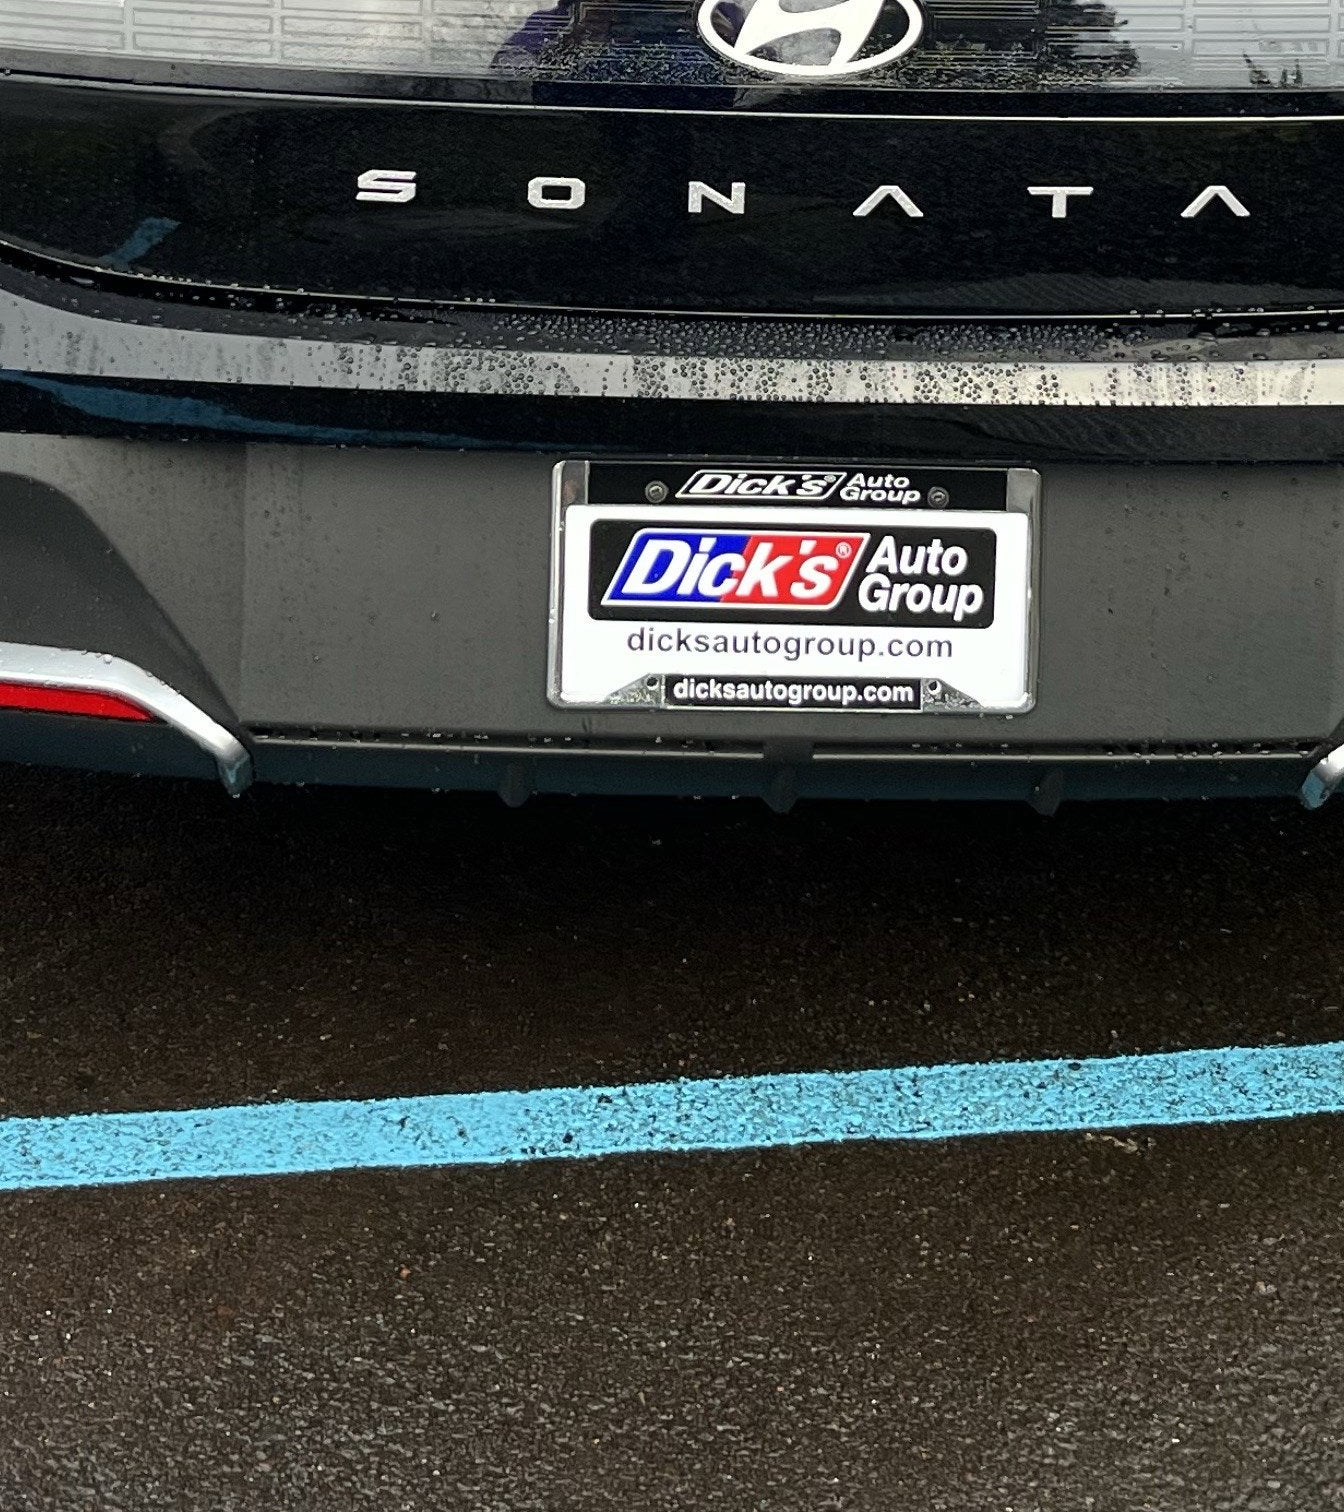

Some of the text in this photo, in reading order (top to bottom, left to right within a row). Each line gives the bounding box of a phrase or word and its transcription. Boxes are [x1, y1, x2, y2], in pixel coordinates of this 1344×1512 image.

[355, 169, 1251, 218] SONATA
[688, 473, 828, 496] Dick's
[840, 487, 921, 504] Group
[846, 473, 911, 488] Auto
[621, 538, 839, 599] Dick's
[866, 535, 969, 577] Auto
[858, 575, 983, 621] Group
[627, 627, 953, 662] dicksautogroup.com
[673, 678, 914, 706] dicksautogroup.com
